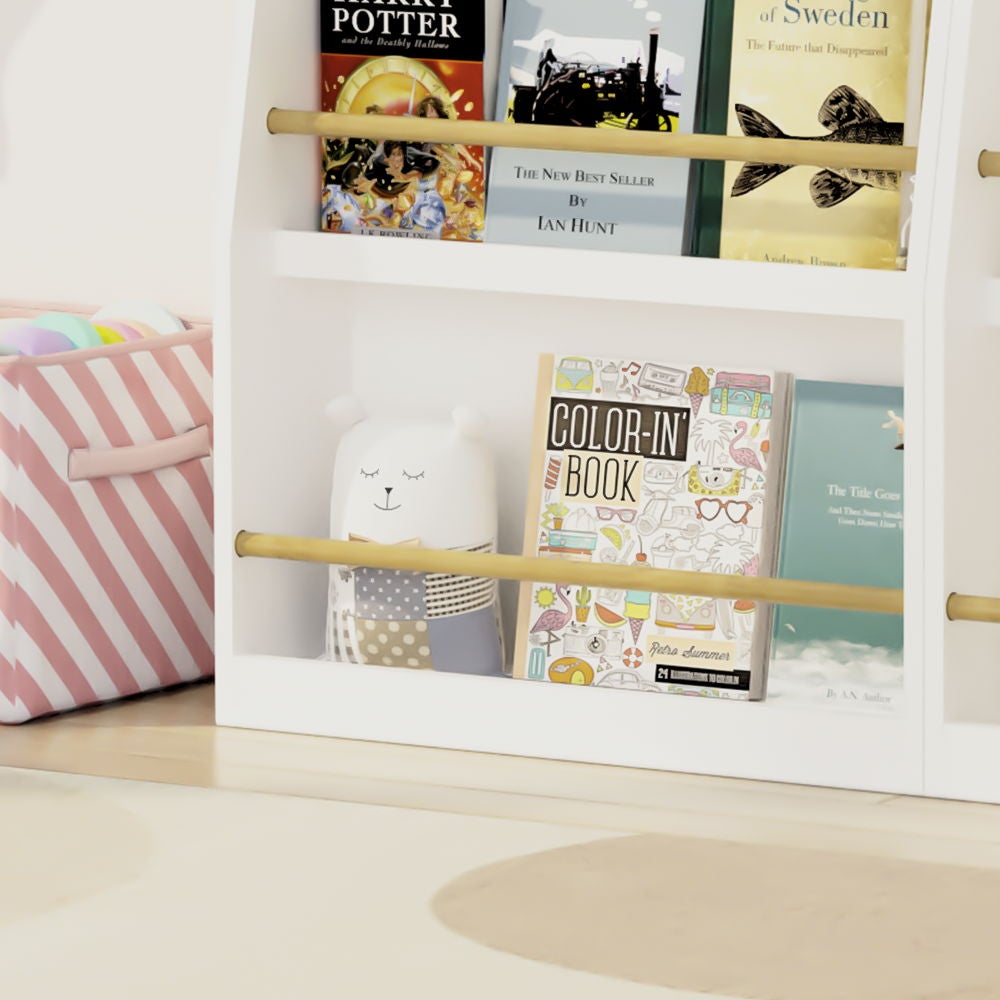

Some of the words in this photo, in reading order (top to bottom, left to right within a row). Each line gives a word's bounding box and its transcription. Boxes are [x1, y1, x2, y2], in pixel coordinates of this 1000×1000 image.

[331, 7, 462, 39] POTTER
[759, 6, 779, 23] of
[341, 35, 358, 45] and
[360, 36, 374, 46] the
[376, 37, 412, 50] Deathly
[414, 38, 450, 50] Hallows
[745, 38, 765, 51] The
[767, 40, 802, 52] Future
[803, 41, 824, 54] that
[826, 42, 889, 58] Disappeared
[513, 165, 540, 181] THE
[542, 167, 572, 182] NEW
[574, 169, 607, 184] BEST
[608, 171, 656, 188] SELLER
[568, 193, 589, 208] BY
[537, 215, 567, 232] IAN
[571, 217, 619, 236] HUNT
[564, 454, 641, 503] BOOK
[648, 641, 679, 658] Retro
[682, 645, 731, 662] Summer
